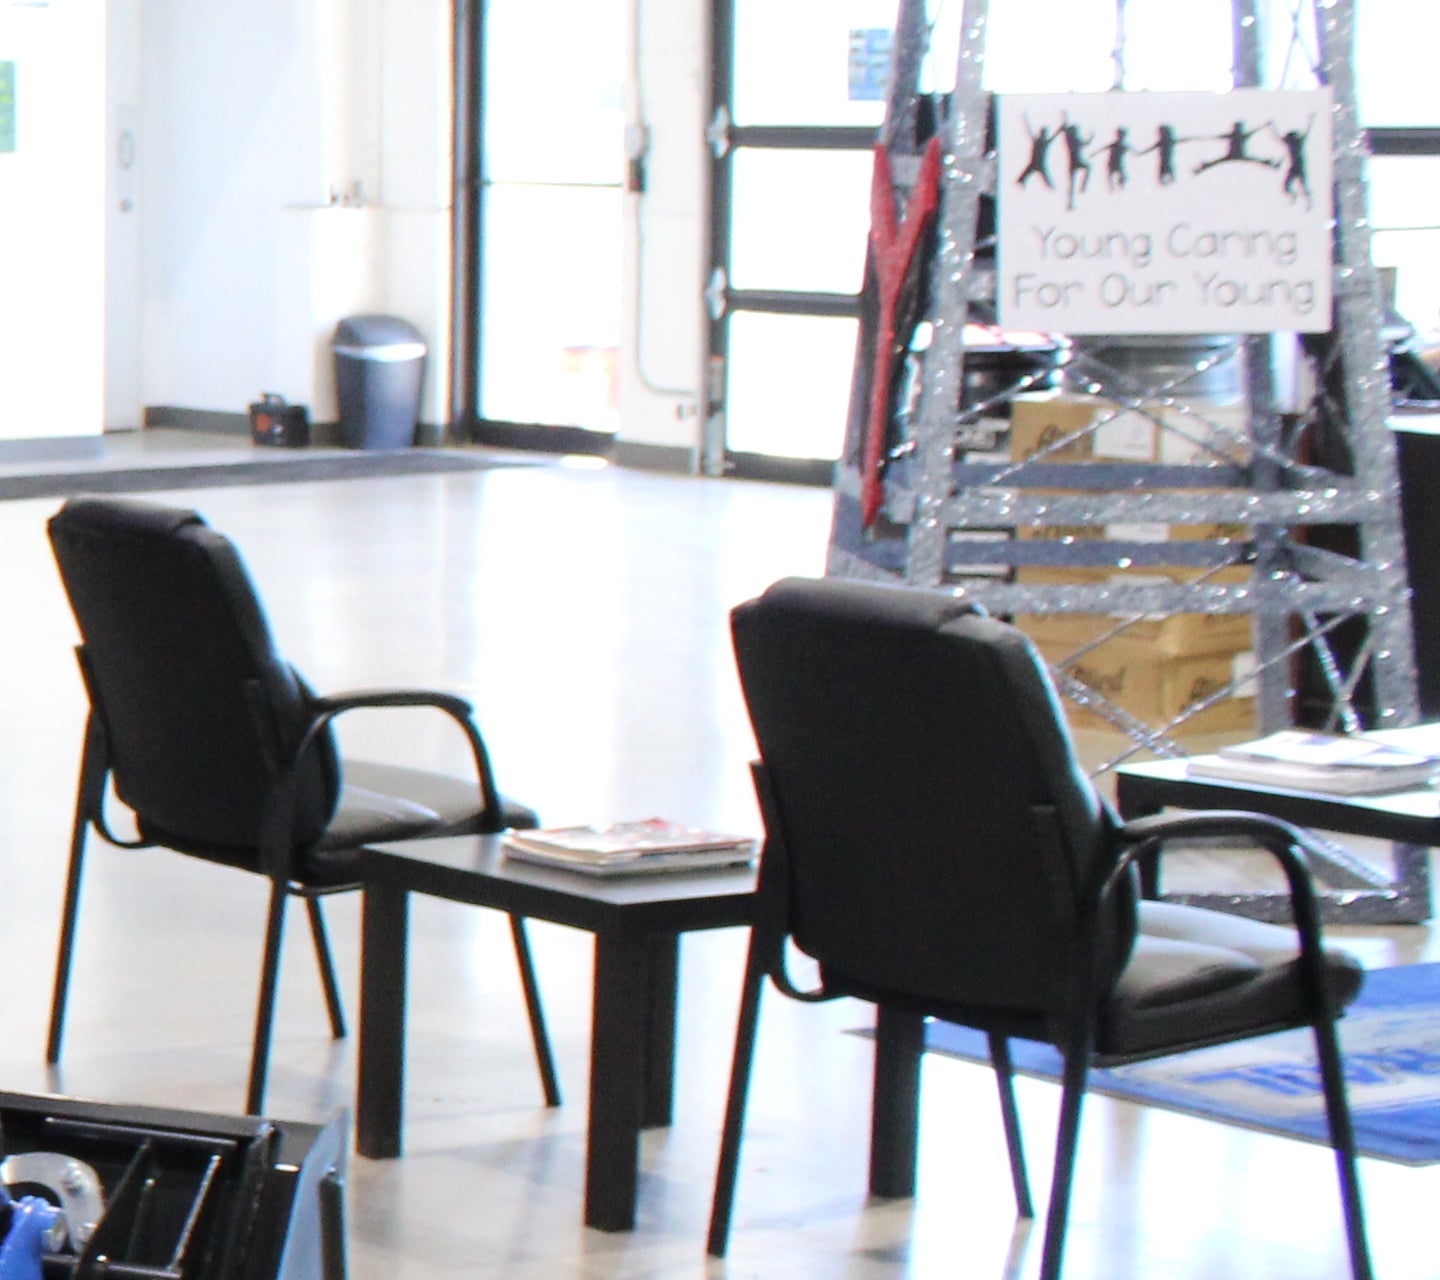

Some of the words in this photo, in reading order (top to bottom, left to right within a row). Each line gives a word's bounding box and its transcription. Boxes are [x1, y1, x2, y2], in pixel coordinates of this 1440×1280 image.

[1031, 223, 1152, 268] Young
[1166, 221, 1298, 266] Caring
[1014, 272, 1084, 309] For
[1099, 272, 1177, 308] Our
[1194, 272, 1316, 316] Young
